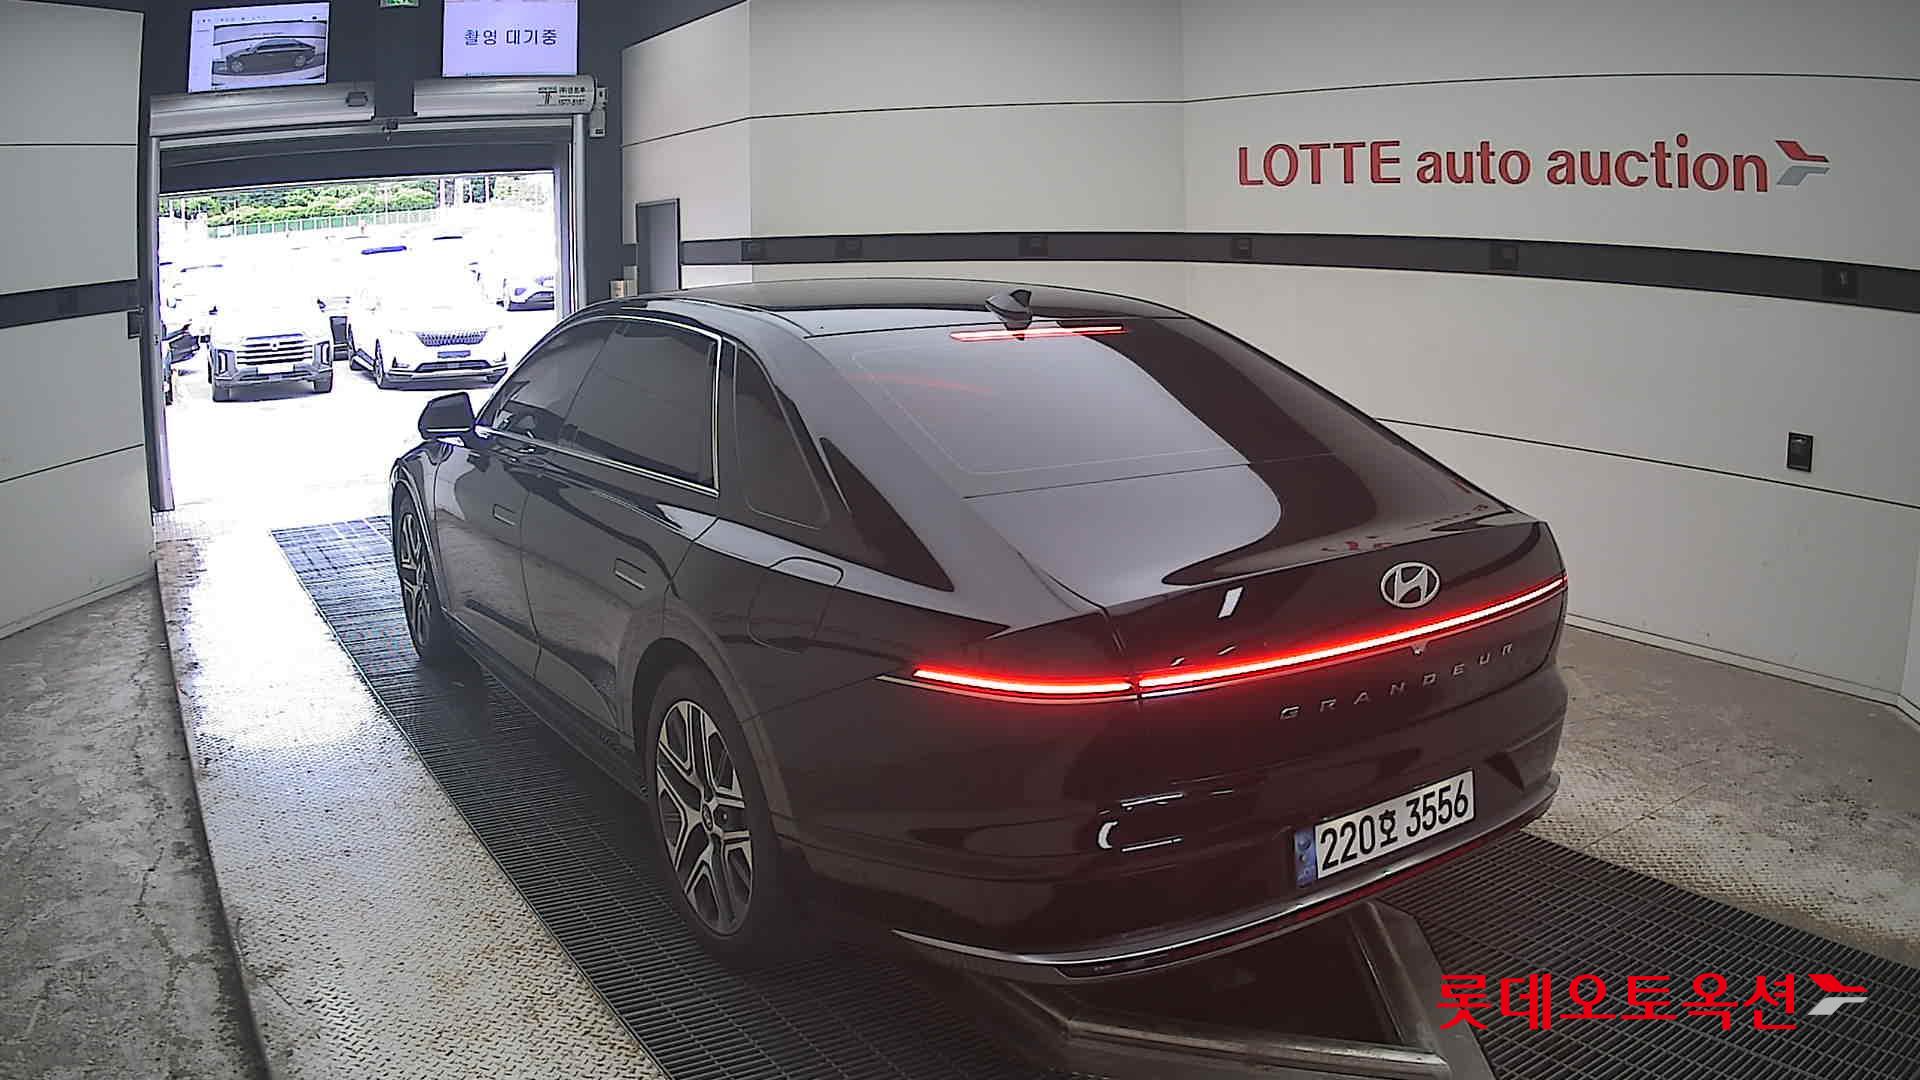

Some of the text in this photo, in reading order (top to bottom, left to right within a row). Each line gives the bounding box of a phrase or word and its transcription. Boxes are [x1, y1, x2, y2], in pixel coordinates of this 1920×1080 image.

[464, 29, 557, 46] 촬영 대기중
[1239, 134, 1769, 192] LOTTE auto auction
[1280, 643, 1513, 720] GRANDEUR
[1405, 779, 1469, 838] 3556
